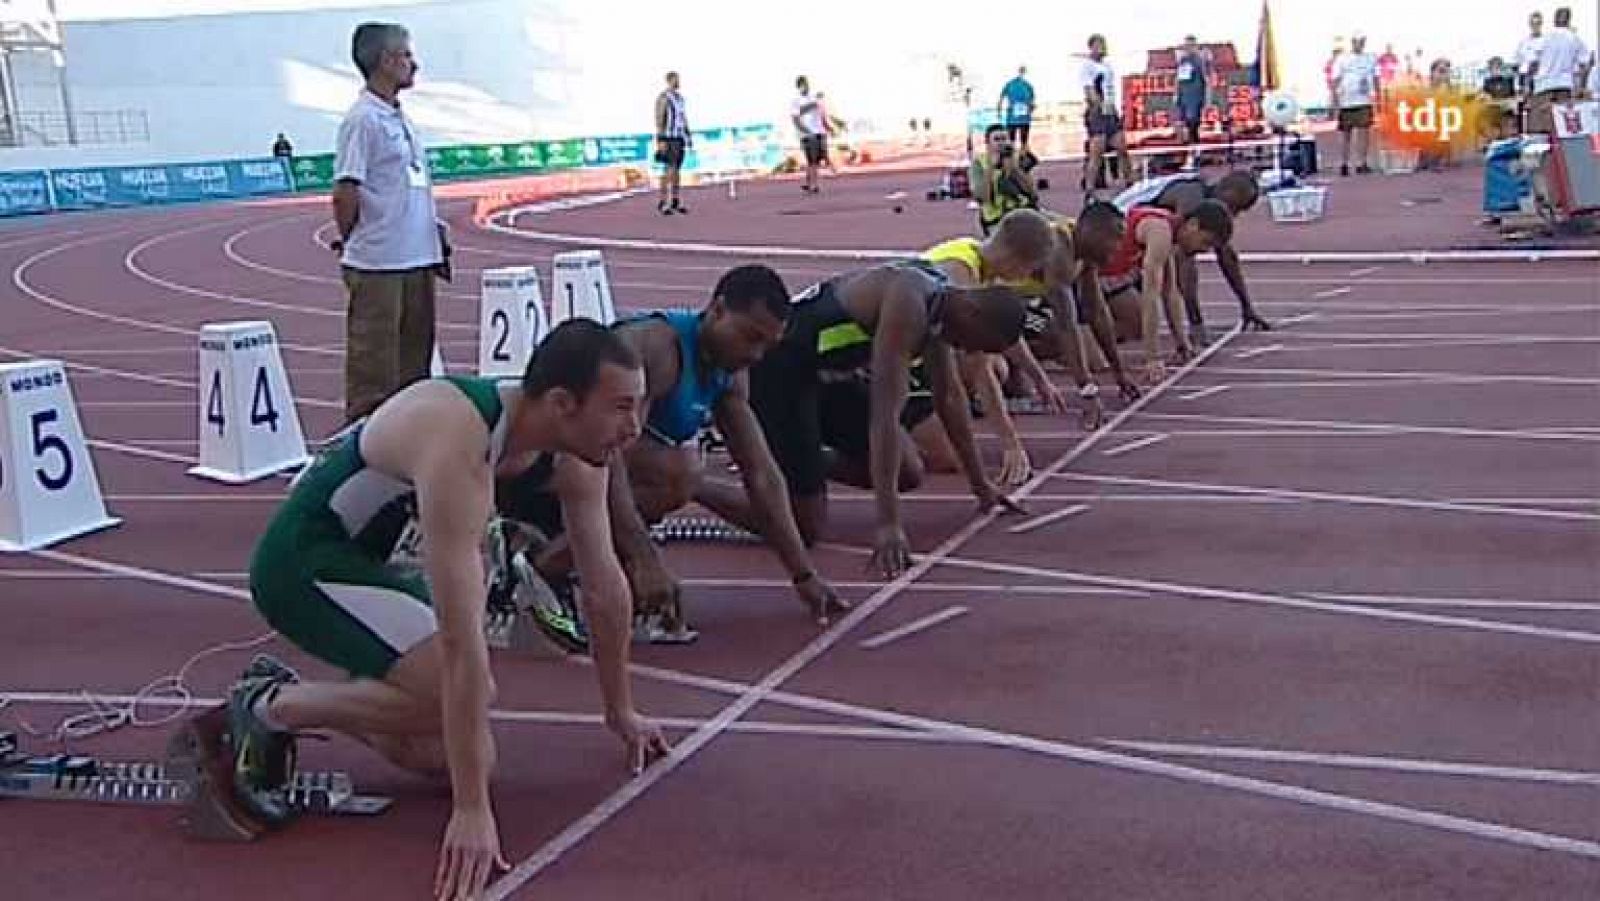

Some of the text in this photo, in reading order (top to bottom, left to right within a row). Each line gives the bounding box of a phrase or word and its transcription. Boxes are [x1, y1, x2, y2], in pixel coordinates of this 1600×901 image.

[491, 310, 511, 361] 2
[11, 372, 62, 392] MONDO
[207, 369, 225, 438] 4
[251, 366, 279, 433] 4
[31, 408, 73, 491] 5
